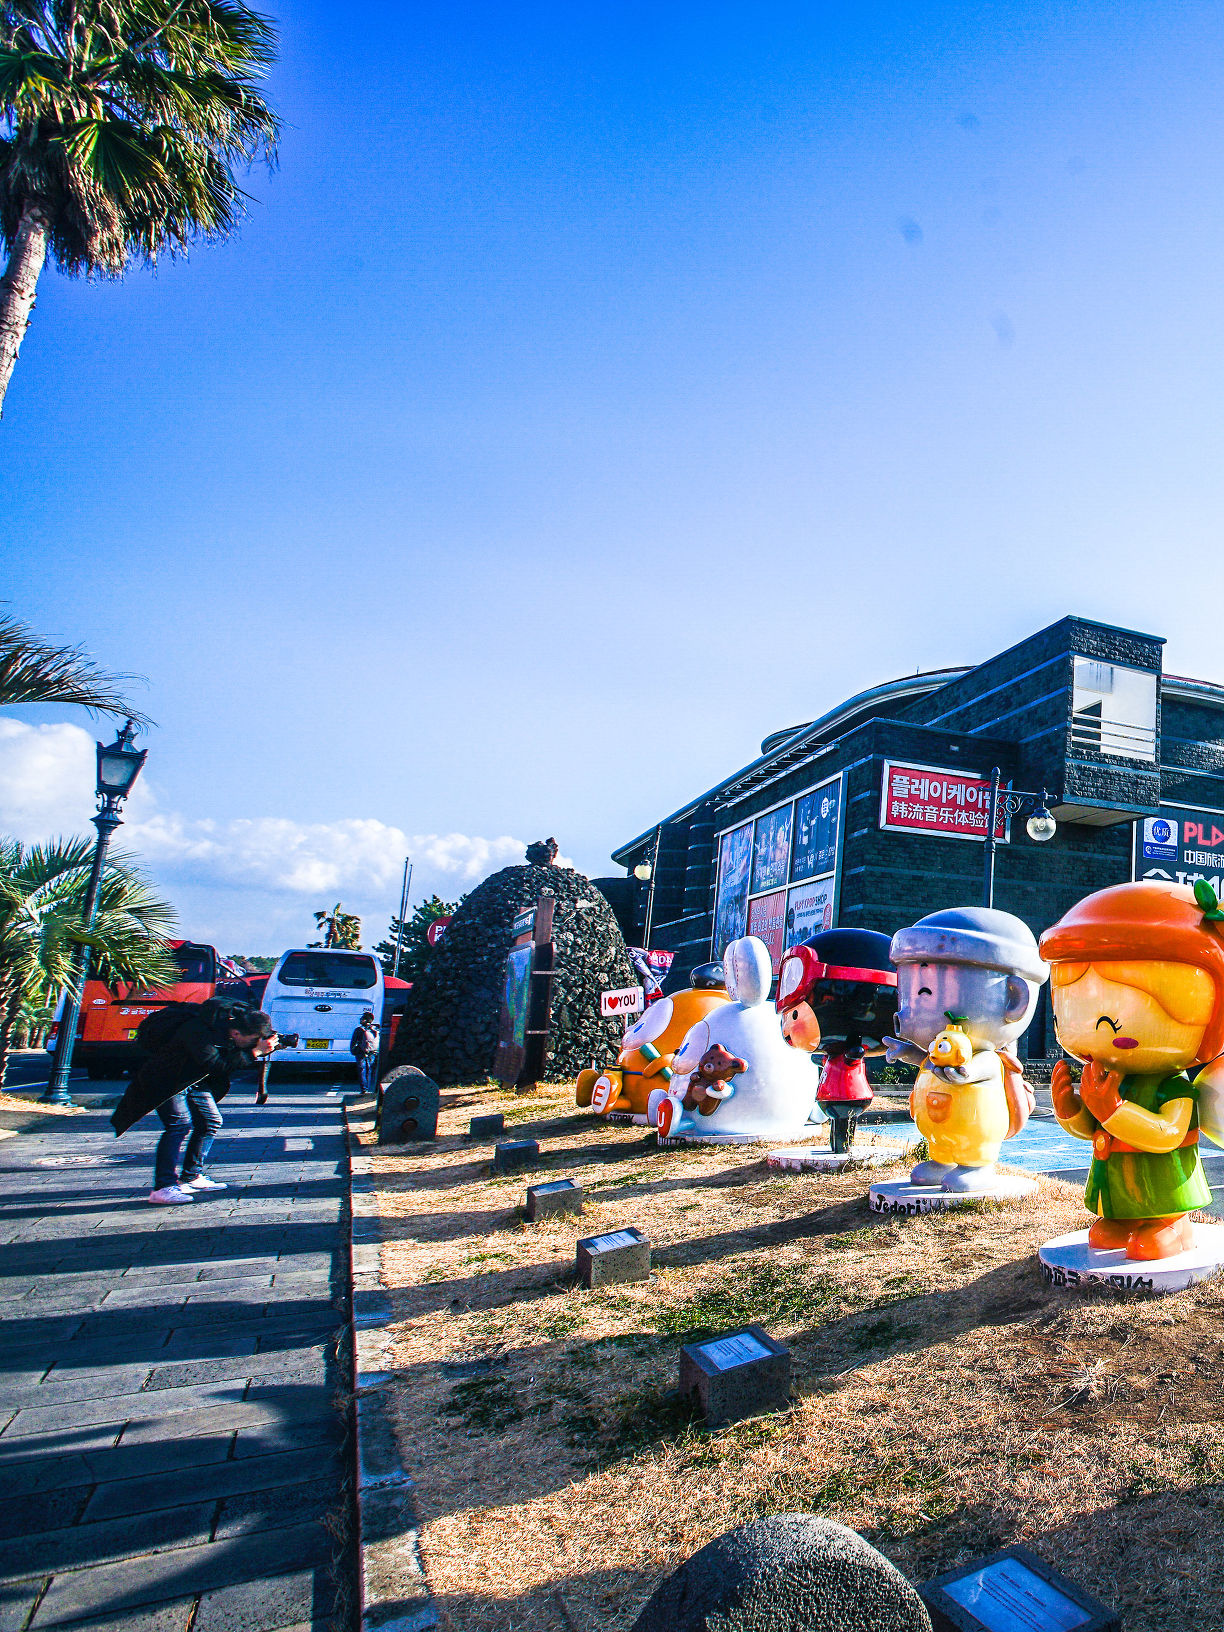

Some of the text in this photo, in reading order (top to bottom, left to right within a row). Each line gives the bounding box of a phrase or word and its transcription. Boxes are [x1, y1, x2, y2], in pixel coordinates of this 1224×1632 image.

[618, 993, 636, 1007] YOU
[593, 1085, 605, 1105] E
[657, 1110, 665, 1127] U
[875, 1194, 921, 1215] Jedori
